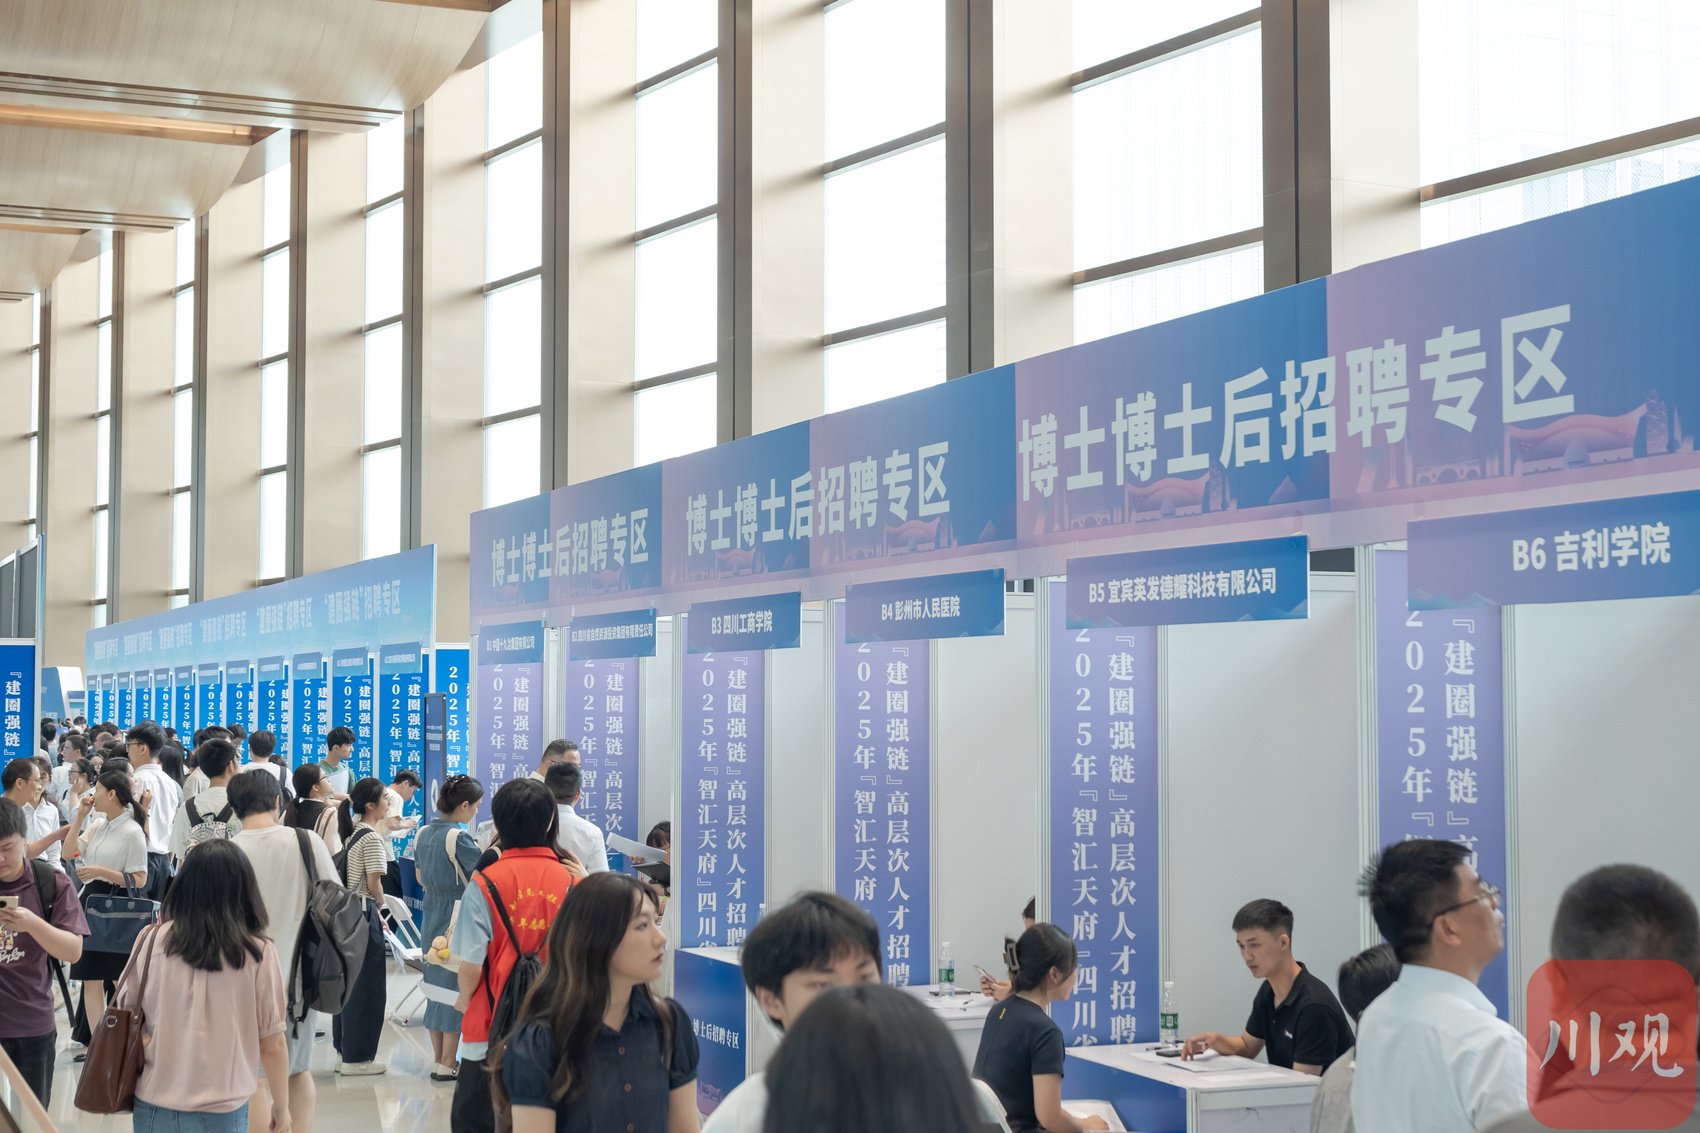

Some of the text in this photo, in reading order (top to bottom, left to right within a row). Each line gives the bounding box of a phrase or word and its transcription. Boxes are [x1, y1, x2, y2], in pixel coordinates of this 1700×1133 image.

[1018, 303, 1575, 501] 博士博士后招聘专区
[686, 441, 950, 557] 博士博士后招聘专区
[492, 508, 649, 588] 博士博士后招聘专区
[1089, 567, 1277, 604] B5 宜宾英发德耀科技有限公司
[1512, 521, 1671, 572] B6 吉利学院
[711, 609, 773, 635] B3 四川工商学院
[881, 595, 960, 621] B4 彭州市人民医院
[3, 671, 22, 767] 『建圈强链』
[1401, 610, 1434, 841] 2025年『
[1108, 635, 1137, 1045] 『建圈强链』高层次人才招聘
